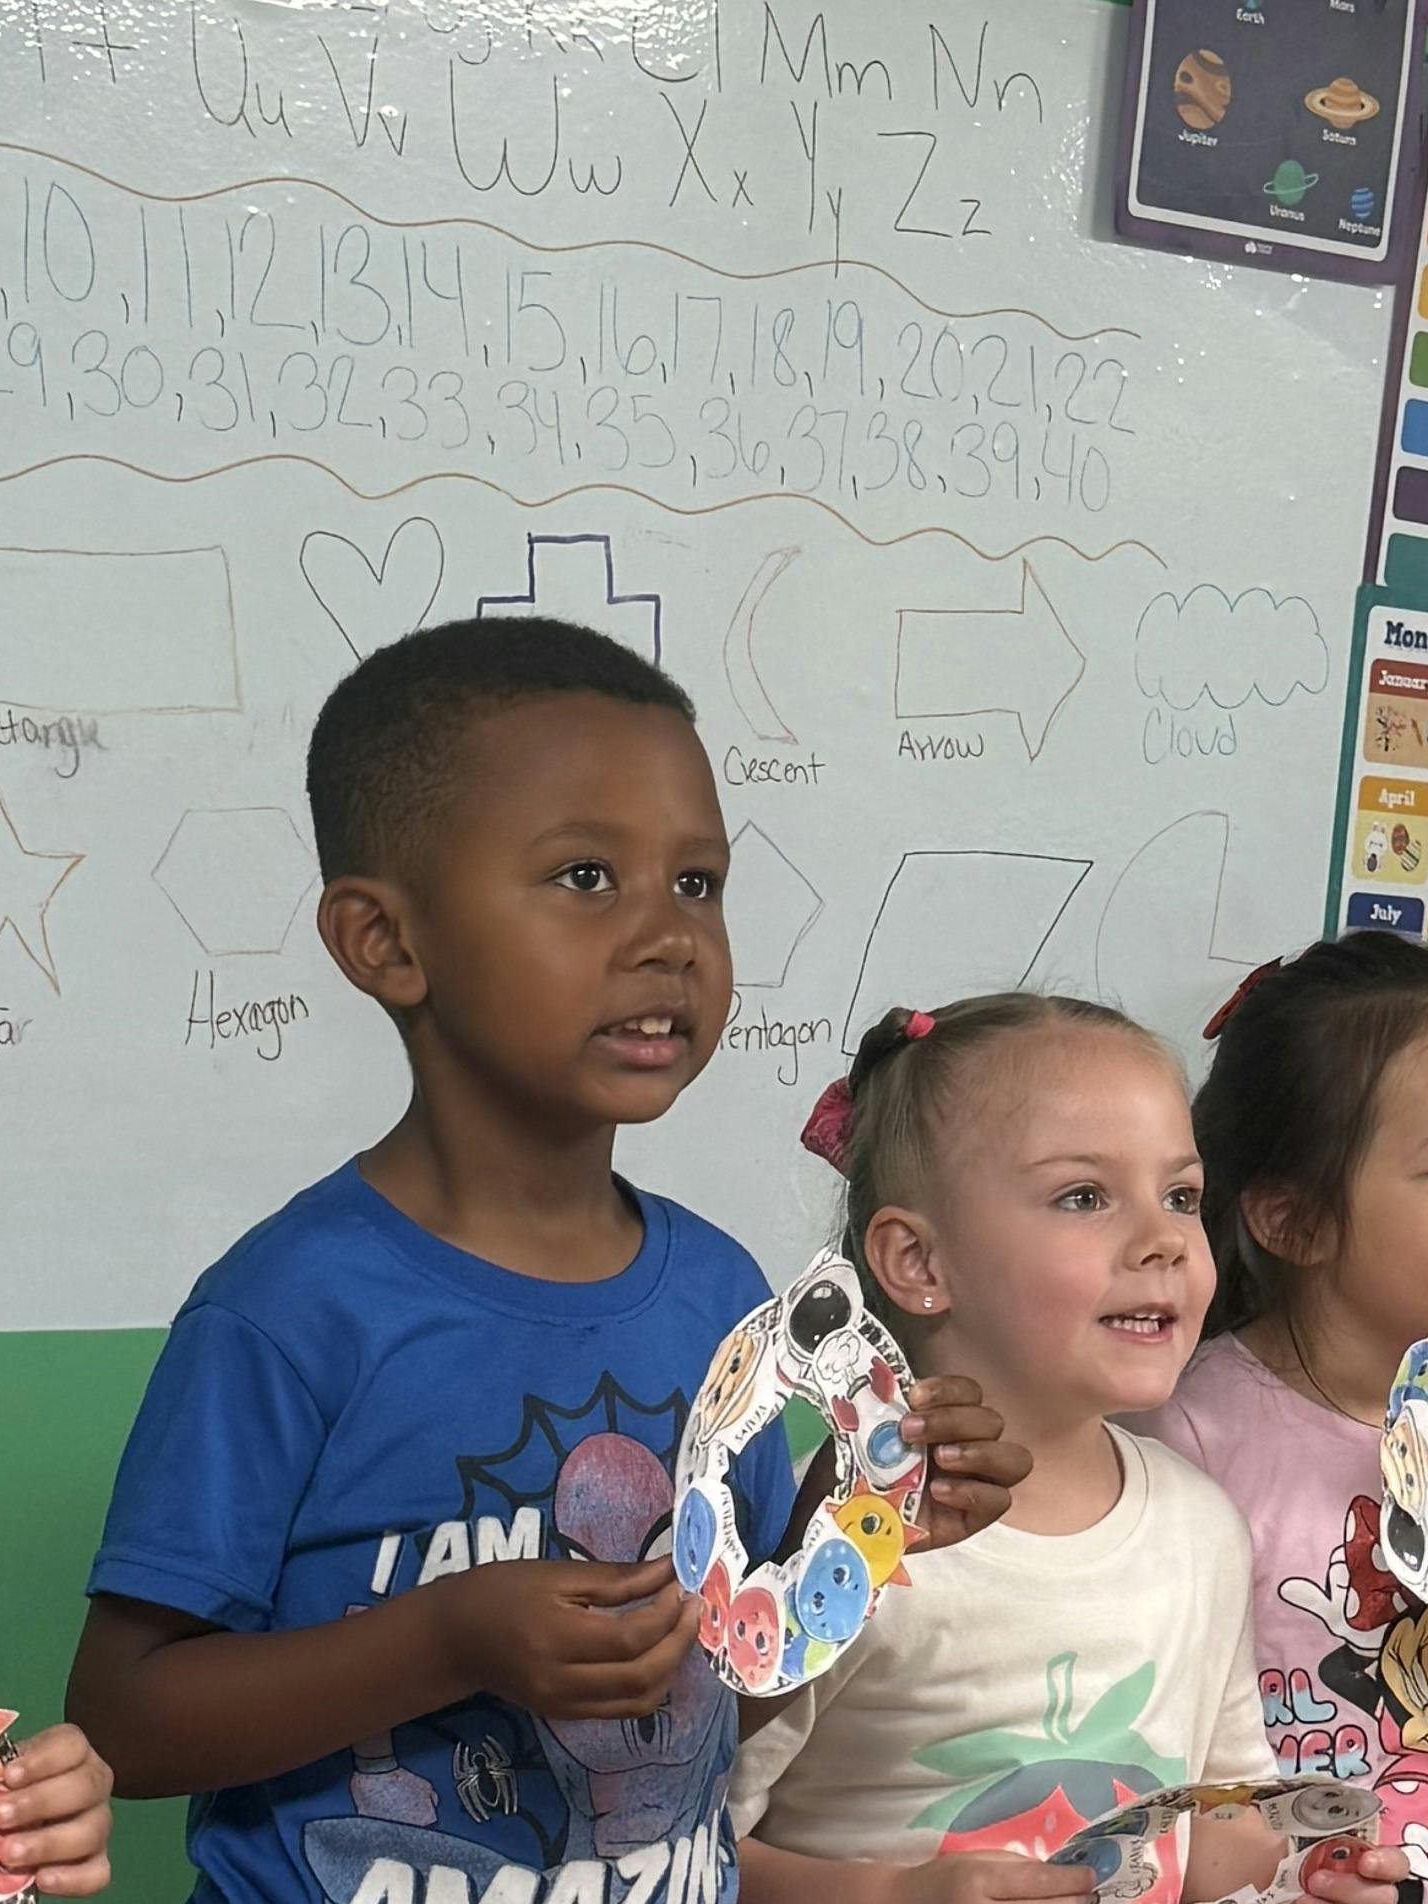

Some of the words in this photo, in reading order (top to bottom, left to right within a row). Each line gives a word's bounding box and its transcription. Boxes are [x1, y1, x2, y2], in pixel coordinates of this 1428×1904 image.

[1235, 8, 1265, 26] Earth
[1178, 129, 1220, 150] Jupiter
[1321, 128, 1358, 147] Saturn
[1269, 202, 1306, 224] Uranus
[1337, 216, 1383, 239] Neptune
[1142, 707, 1239, 760] Cloud
[897, 730, 986, 762] Arrow
[723, 742, 827, 787] Crescent
[1377, 787, 1417, 809] April
[1369, 904, 1403, 927] July
[182, 969, 310, 1062] Hexagon
[372, 1533, 402, 1596] I
[416, 1506, 542, 1587] AM
